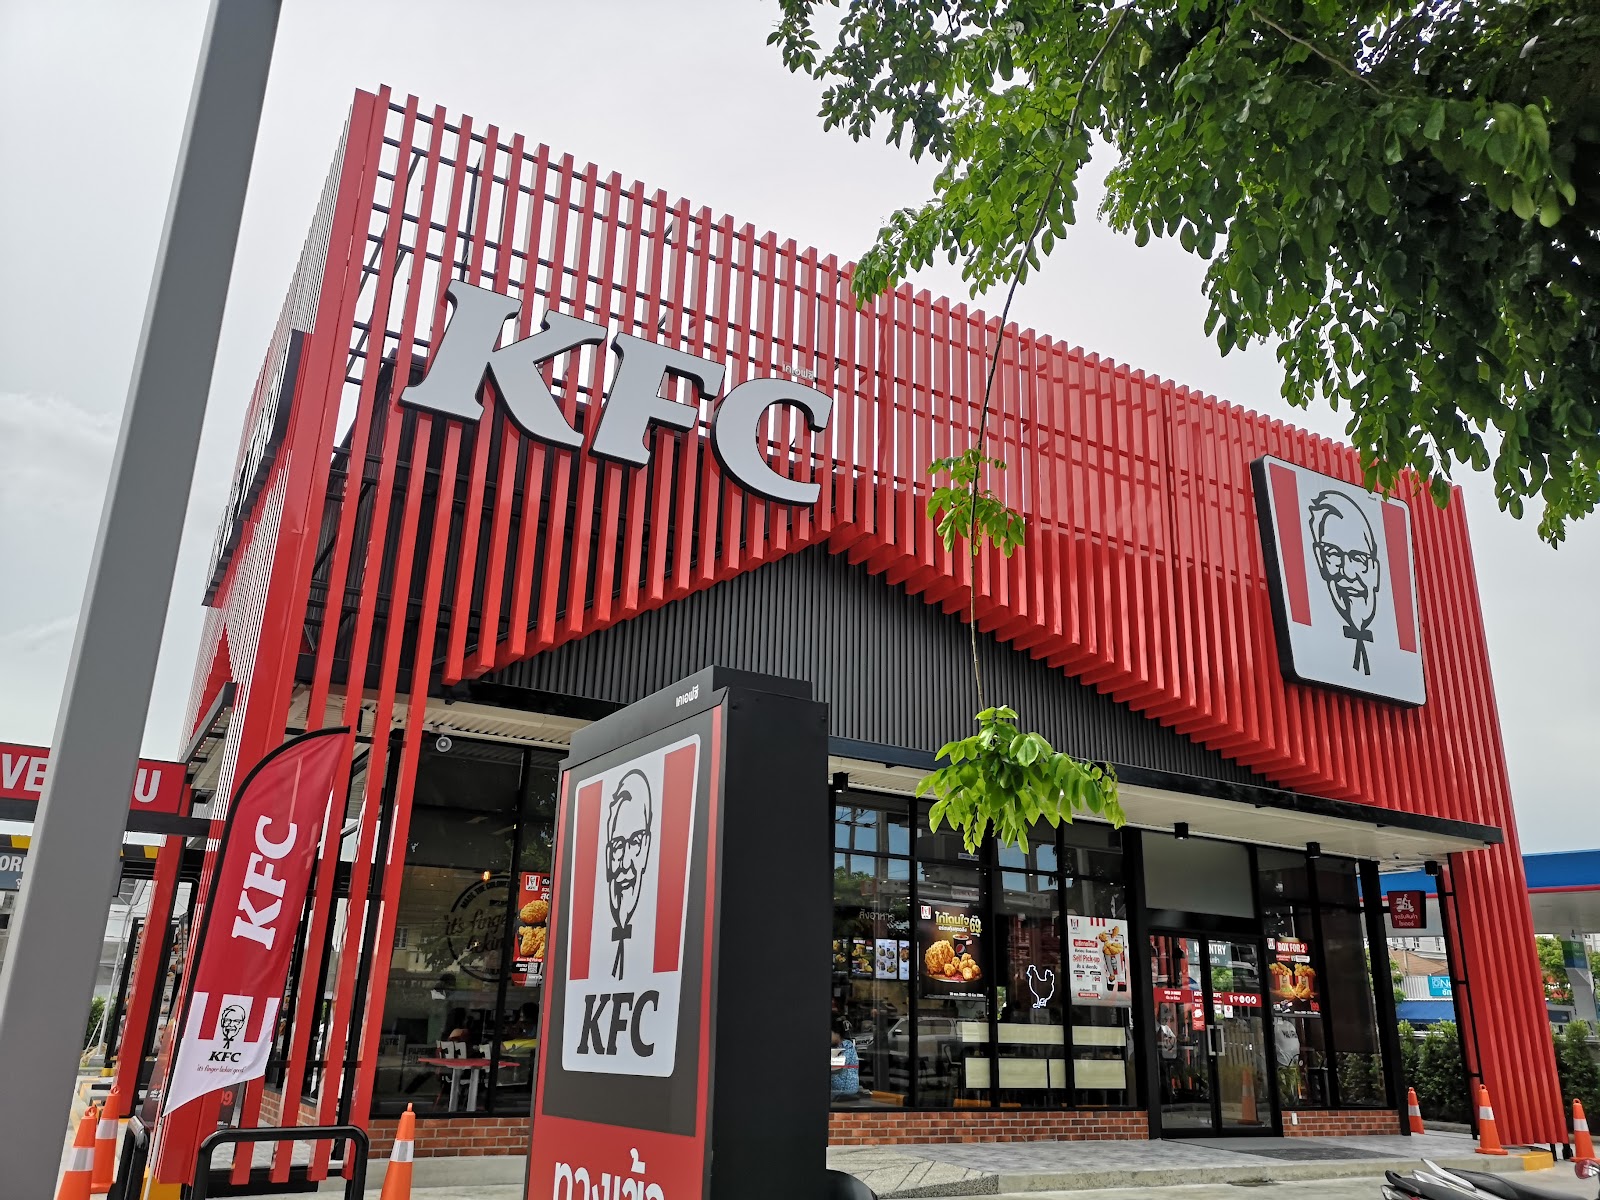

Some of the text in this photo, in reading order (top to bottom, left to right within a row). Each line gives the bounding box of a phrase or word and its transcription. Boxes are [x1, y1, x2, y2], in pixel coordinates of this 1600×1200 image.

[400, 278, 834, 506] KFC
[675, 684, 700, 708] เคเอฟซี
[231, 814, 298, 951] KFC
[1277, 942, 1306, 954] BOX FOR 2
[576, 990, 660, 1059] KFC
[208, 1051, 241, 1062] KFC
